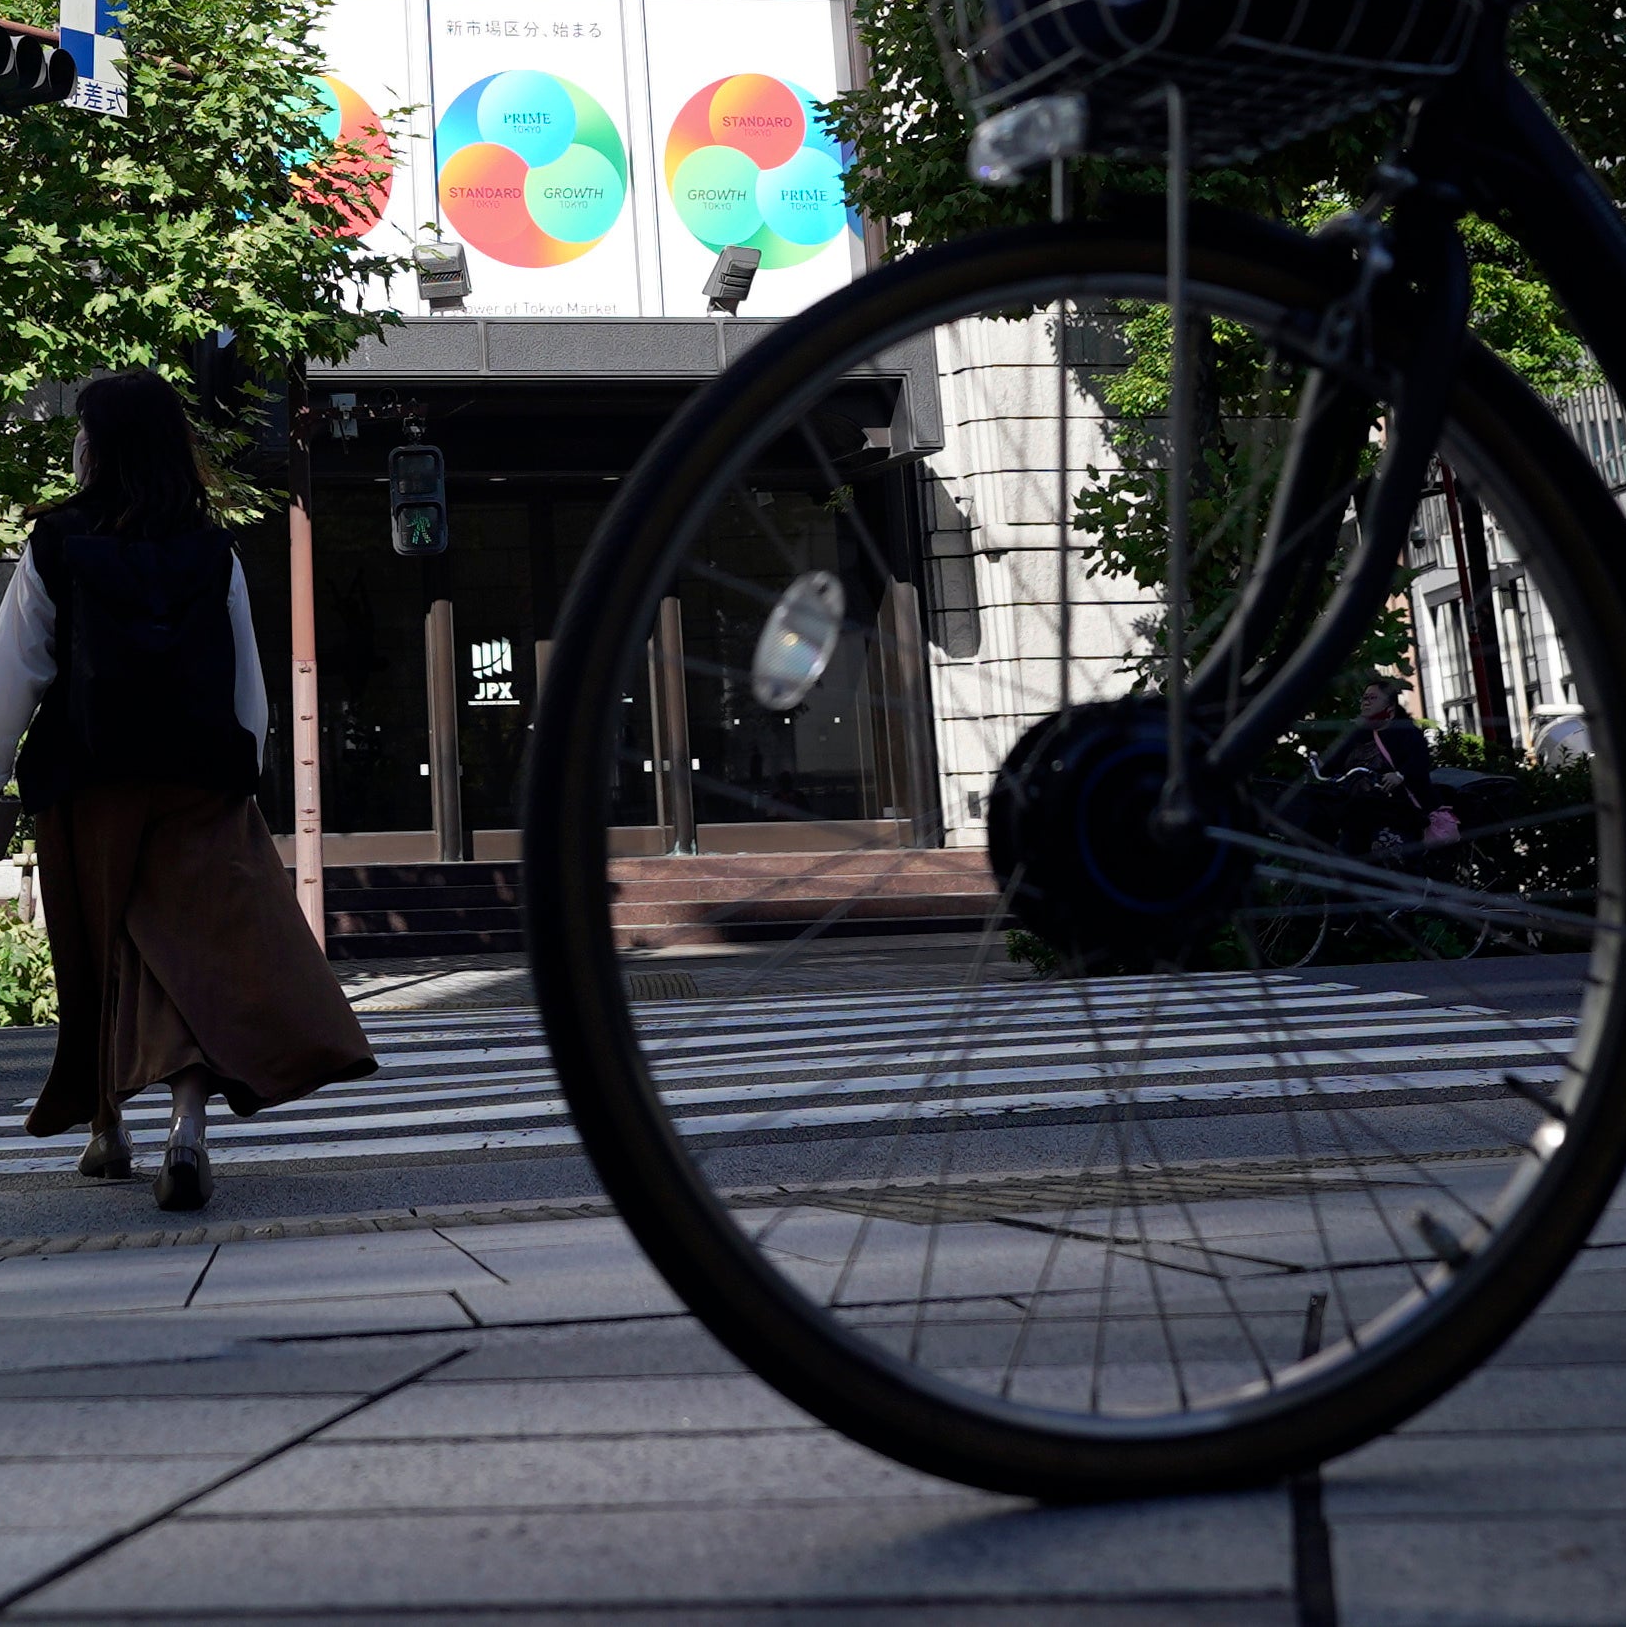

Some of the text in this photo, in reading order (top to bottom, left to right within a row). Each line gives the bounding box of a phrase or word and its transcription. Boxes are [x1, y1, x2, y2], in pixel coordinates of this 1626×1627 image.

[446, 19, 602, 39] 新市場区分、始まる
[504, 112, 552, 125] PRIME
[722, 115, 793, 128] STANDARD
[513, 125, 542, 134] TOKYO
[744, 128, 772, 137] TOKYO
[449, 187, 522, 199] STANDARD
[543, 187, 604, 199] GROWTH
[687, 188, 747, 201] GROWTH
[781, 189, 829, 202] PRIME
[472, 200, 501, 209] TOKYO
[559, 200, 589, 209] TOKYO
[703, 202, 732, 211] TOKYO
[791, 202, 819, 211] TOKYO
[464, 302, 618, 317] ower of Tokyo Market
[474, 682, 513, 700] JPX
